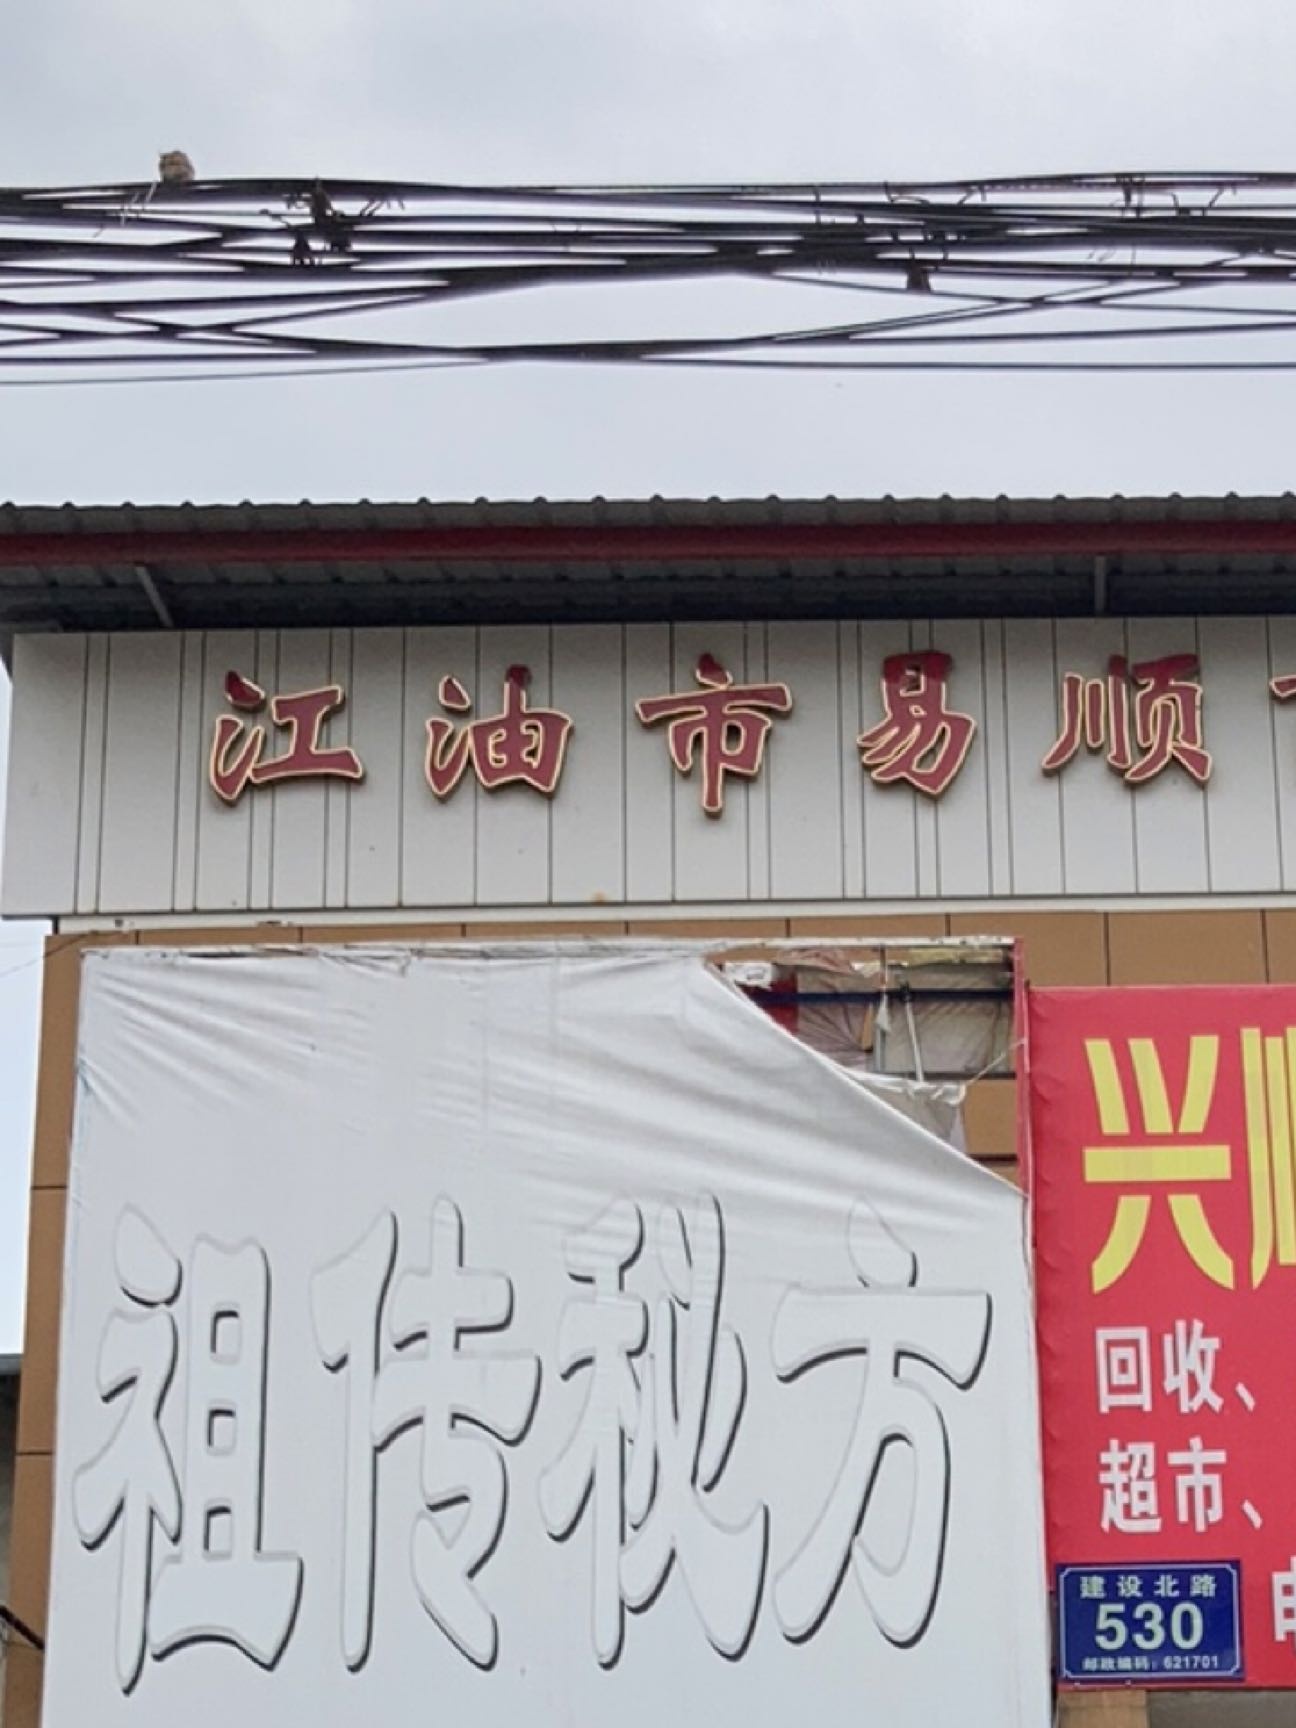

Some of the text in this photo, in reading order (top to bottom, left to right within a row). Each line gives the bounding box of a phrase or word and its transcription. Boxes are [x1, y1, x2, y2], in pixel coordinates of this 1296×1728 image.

[72, 1188, 993, 1696] 祖传秘方
[1079, 1574, 1217, 1599] 建设北路
[1094, 1601, 1204, 1651] 530
